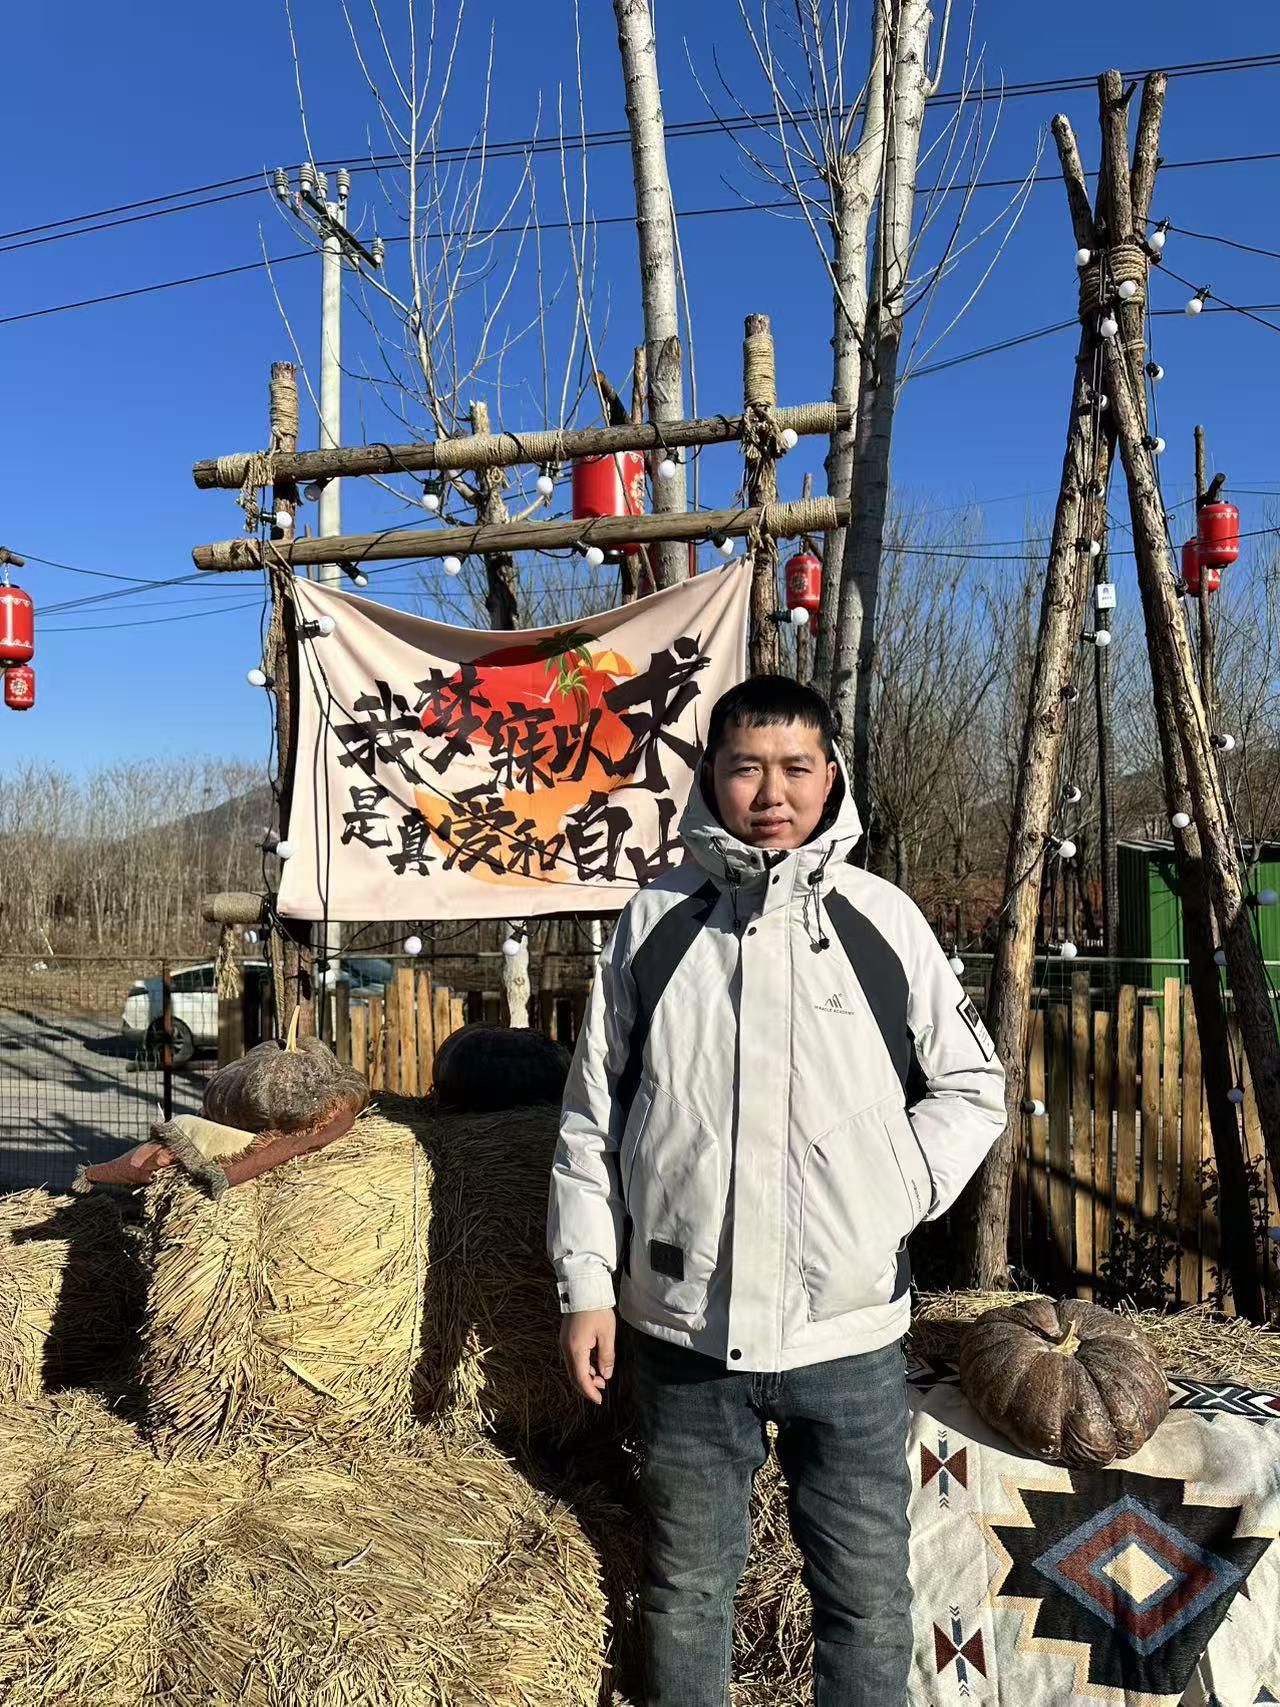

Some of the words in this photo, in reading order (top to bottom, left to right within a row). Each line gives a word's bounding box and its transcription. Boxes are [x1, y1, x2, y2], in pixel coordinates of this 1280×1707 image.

[334, 631, 710, 793] 我梦寐以求
